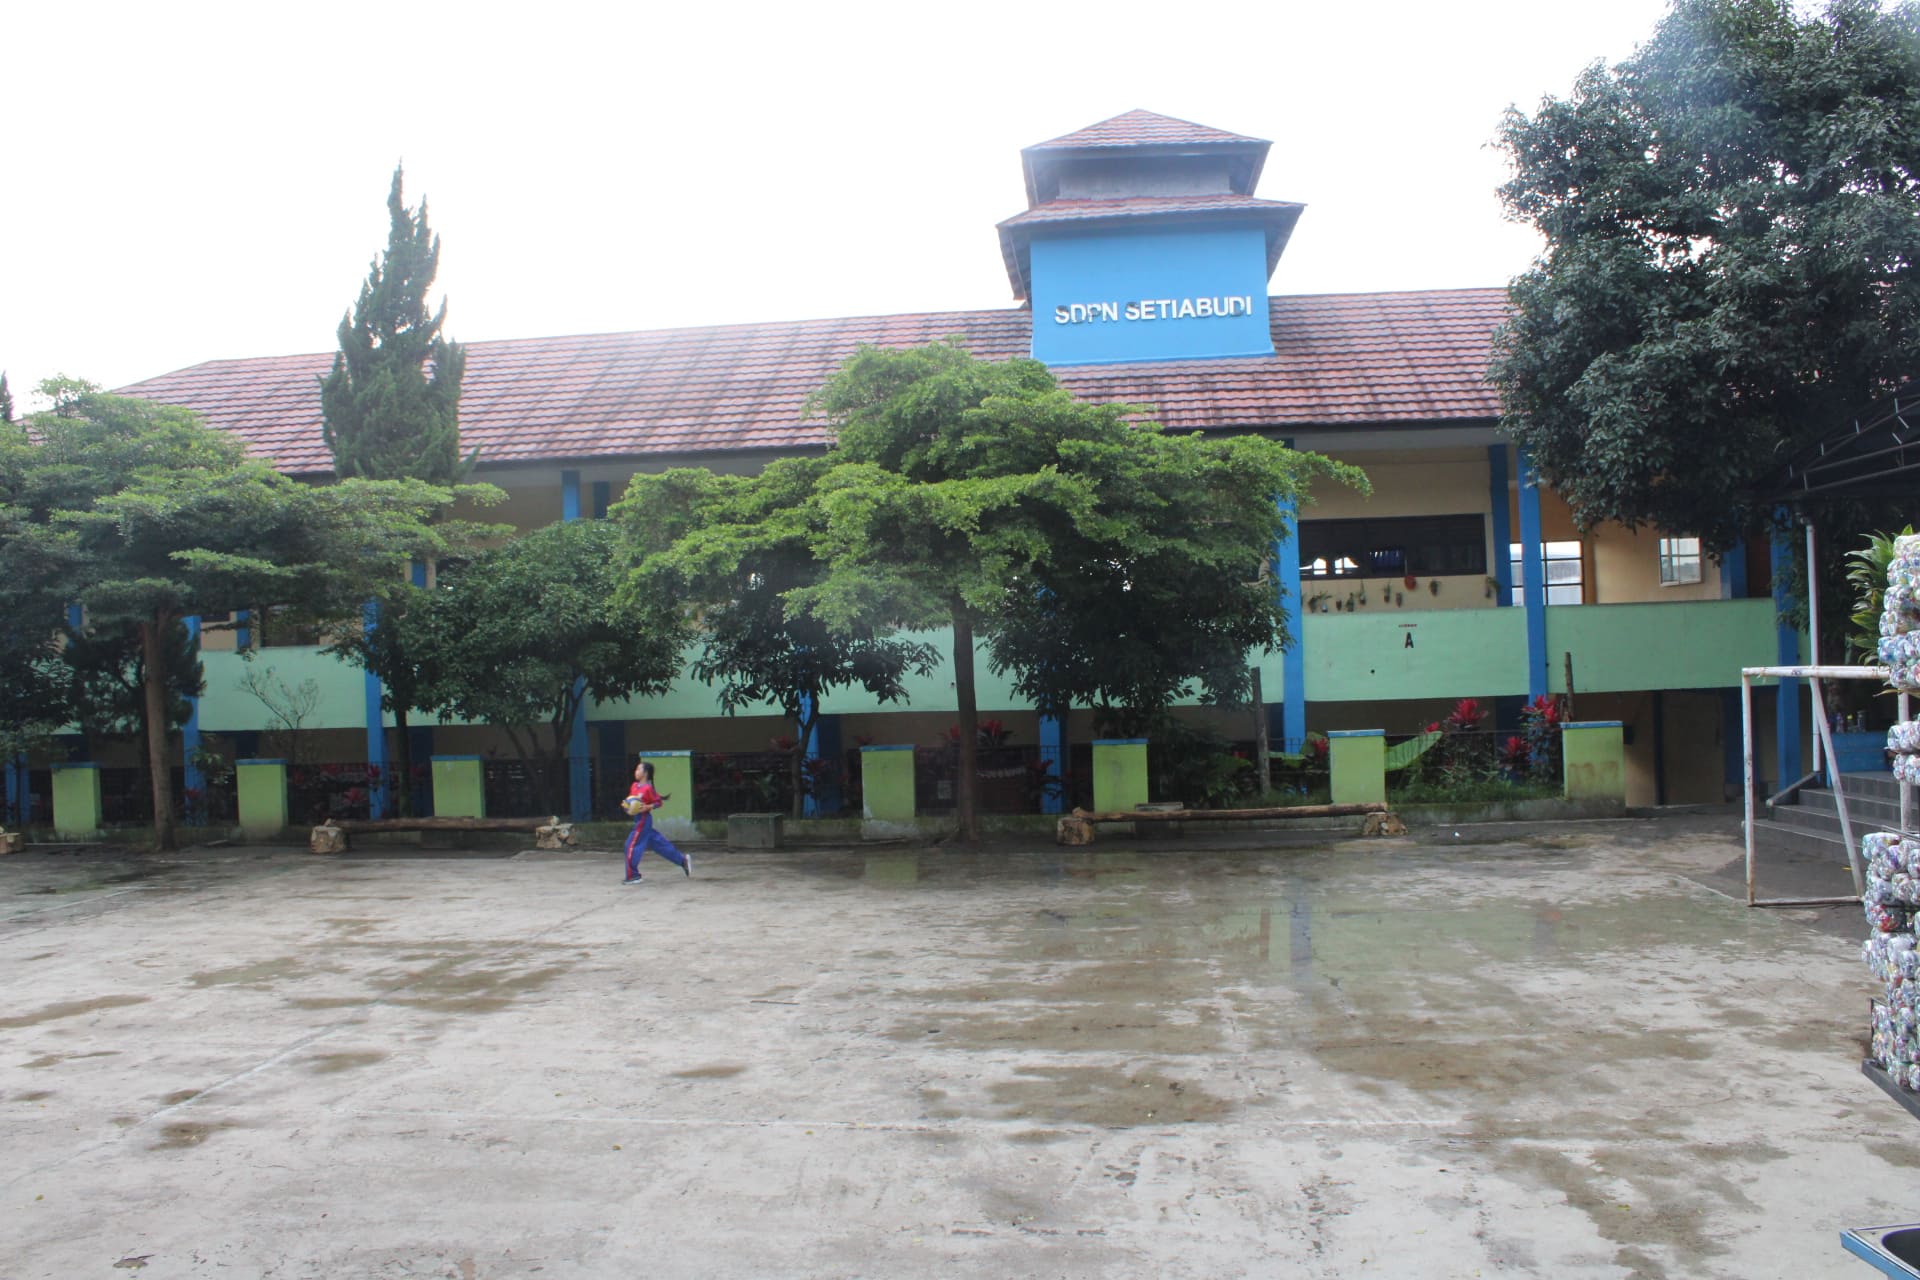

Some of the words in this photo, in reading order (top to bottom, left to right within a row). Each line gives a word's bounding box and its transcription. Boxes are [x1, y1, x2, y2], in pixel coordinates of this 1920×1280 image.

[1055, 302, 1118, 324] SDPN
[1125, 296, 1252, 321] SETIABUDI
[1404, 632, 1415, 649] A
